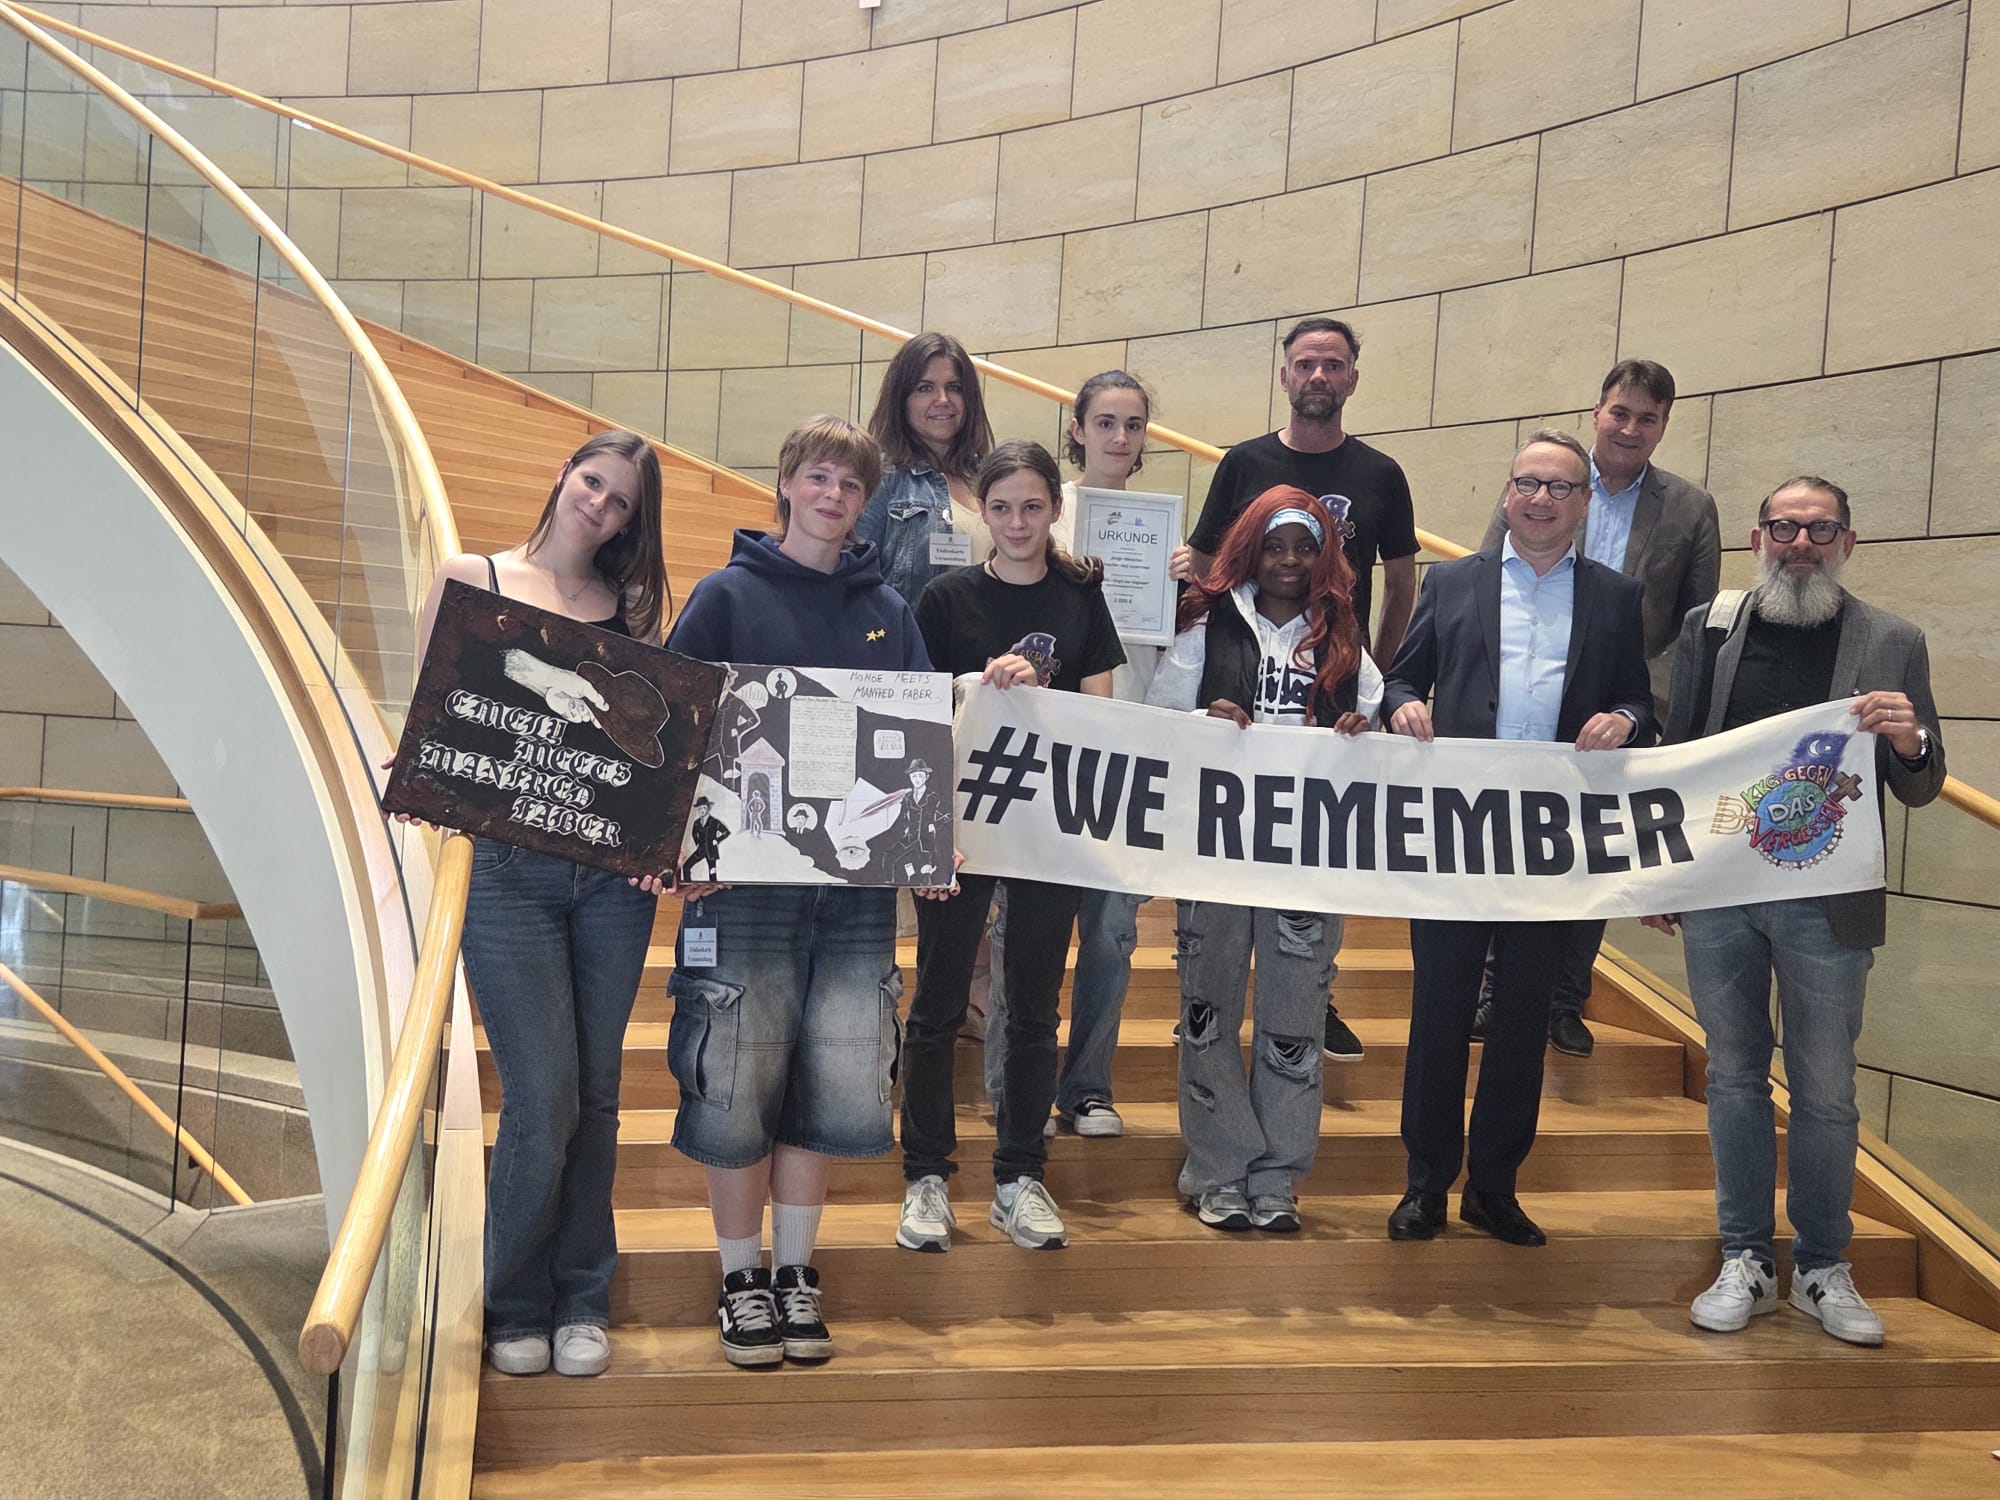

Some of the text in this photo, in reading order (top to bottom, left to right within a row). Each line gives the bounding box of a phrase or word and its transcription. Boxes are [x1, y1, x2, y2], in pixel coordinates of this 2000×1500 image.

[1098, 529, 1158, 544] URKUNDE
[902, 688, 933, 700] FABER
[1784, 765, 1834, 790] GEGEN
[956, 725, 1695, 876] #WE REMEMBER
[1767, 794, 1817, 823] DAS
[1749, 798, 1848, 851] VERGESSEN
